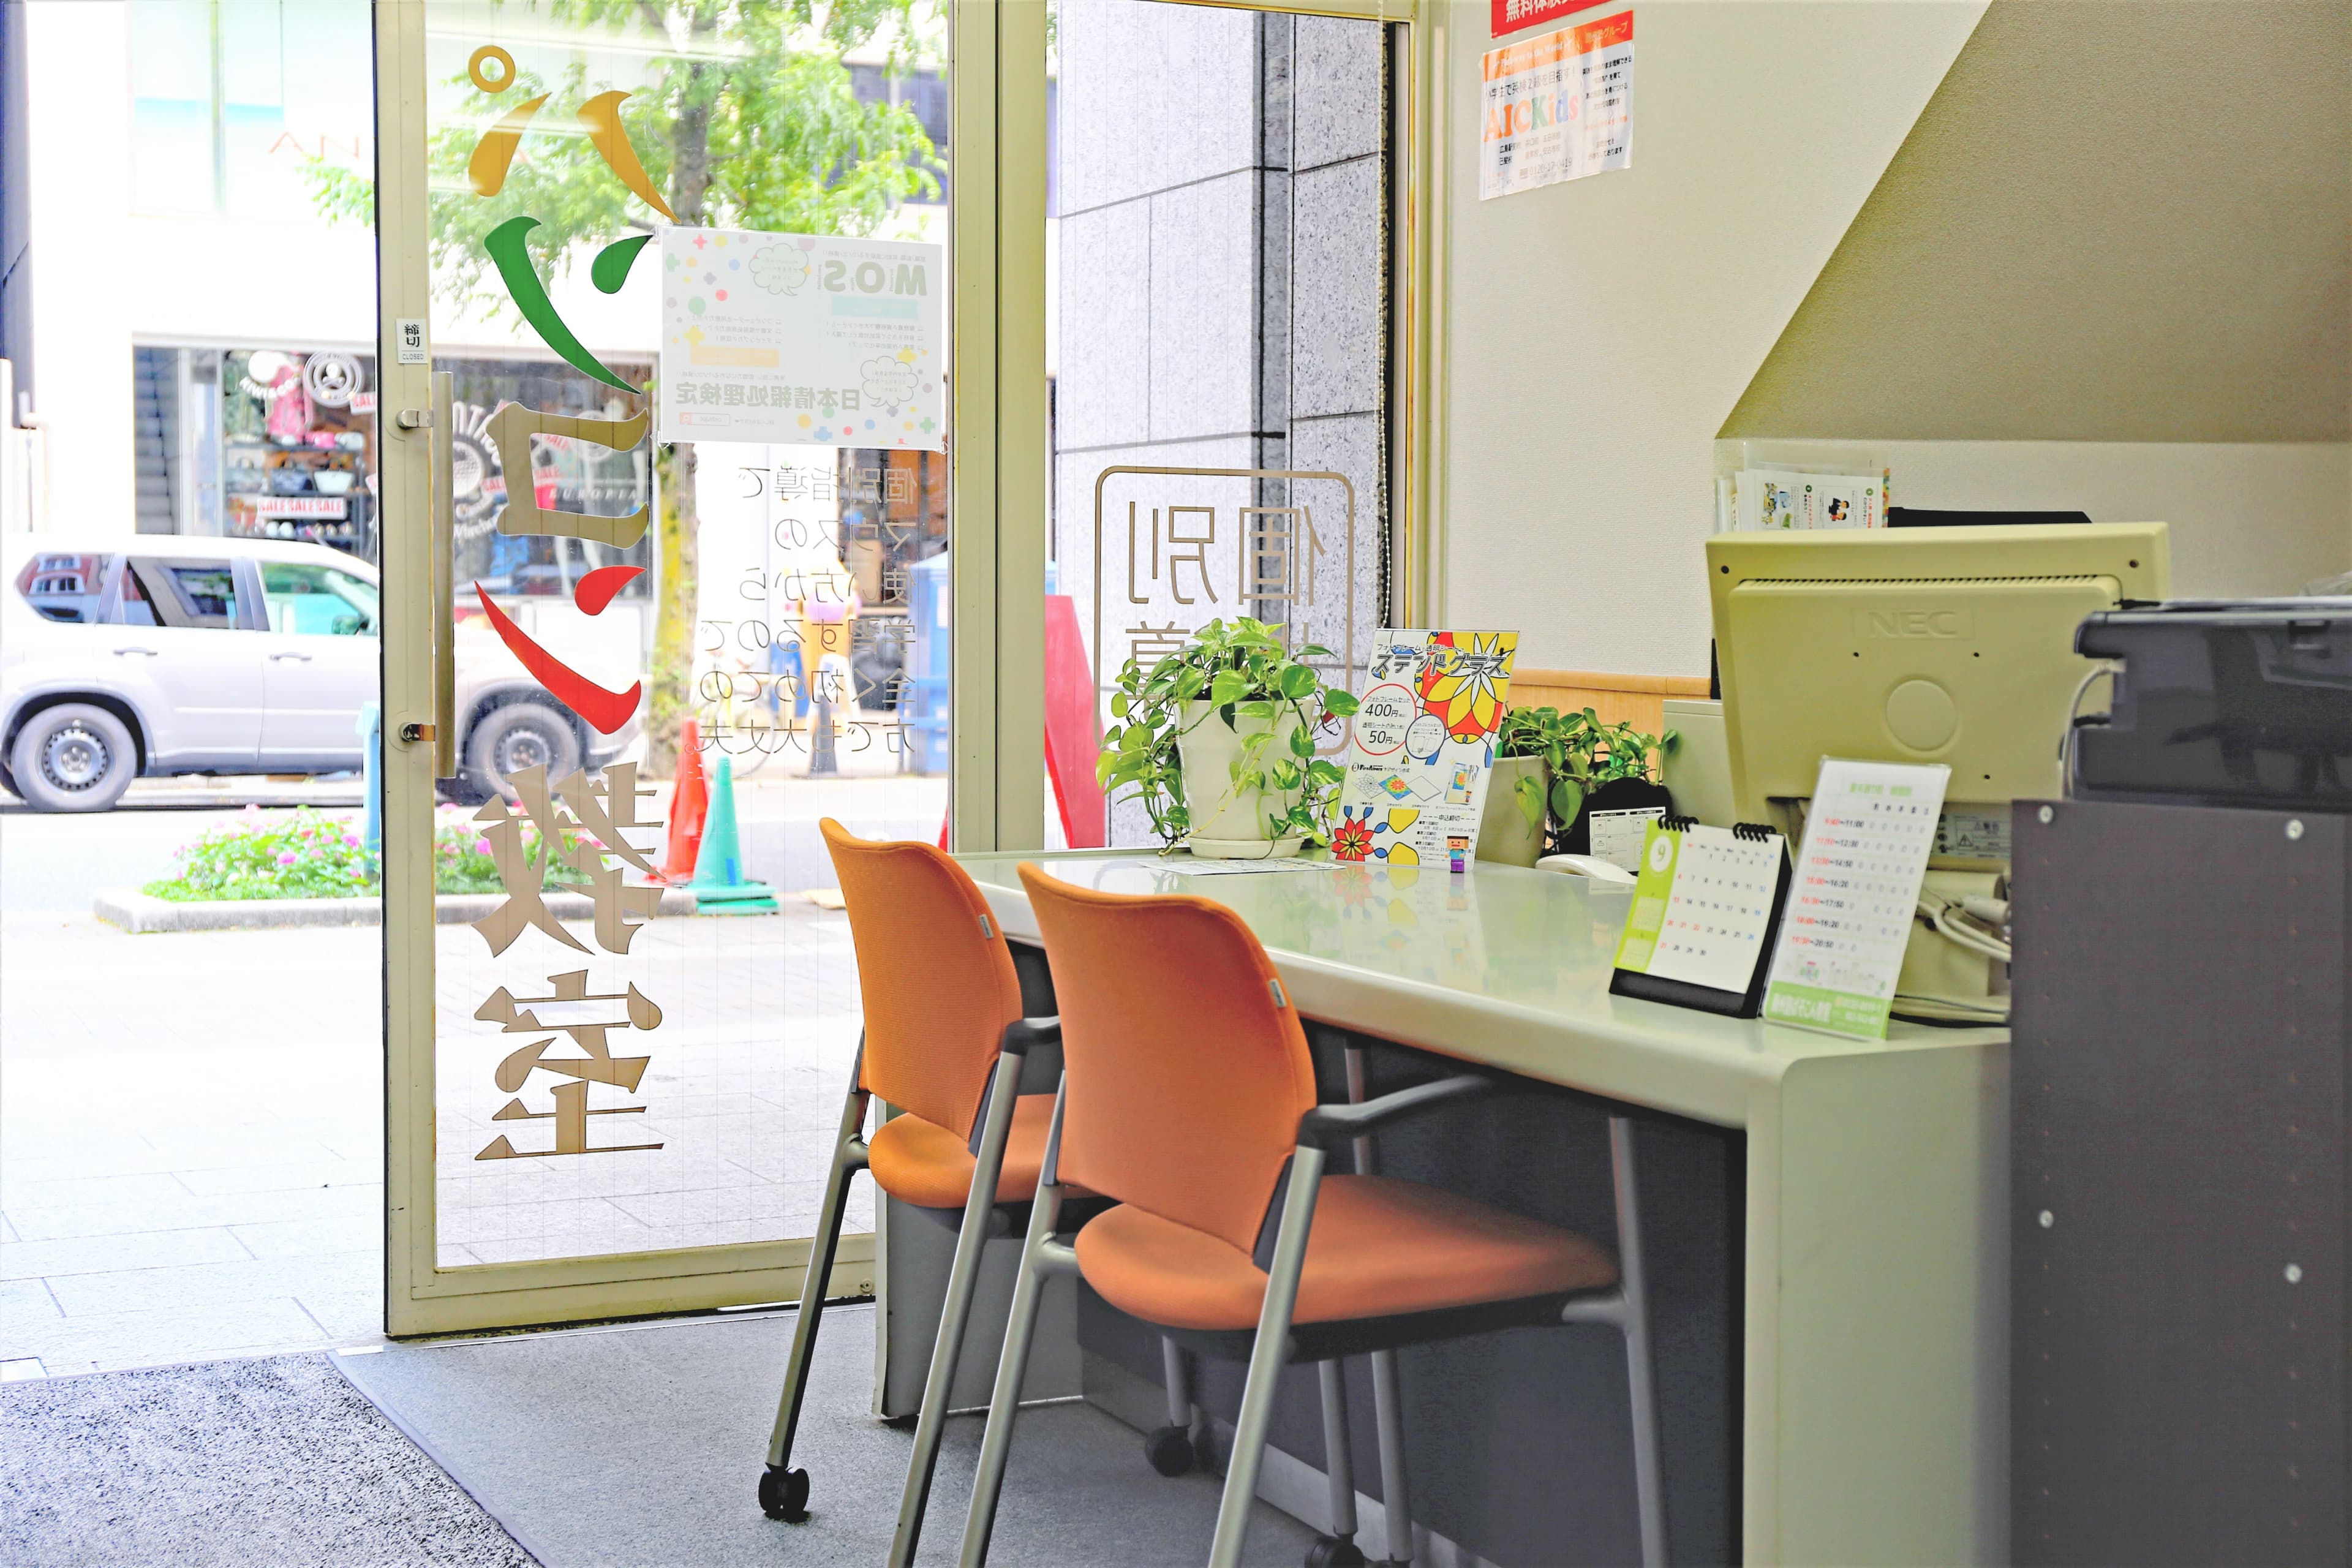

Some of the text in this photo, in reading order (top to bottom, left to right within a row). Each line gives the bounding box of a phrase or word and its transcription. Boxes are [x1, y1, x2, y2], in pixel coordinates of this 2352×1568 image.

[404, 323, 421, 349] 締切
[402, 352, 424, 361] CLOSED
[258, 499, 343, 513] SALE SALE SALE
[1868, 611, 1958, 638] NEC
[1657, 843, 1667, 862] 9
